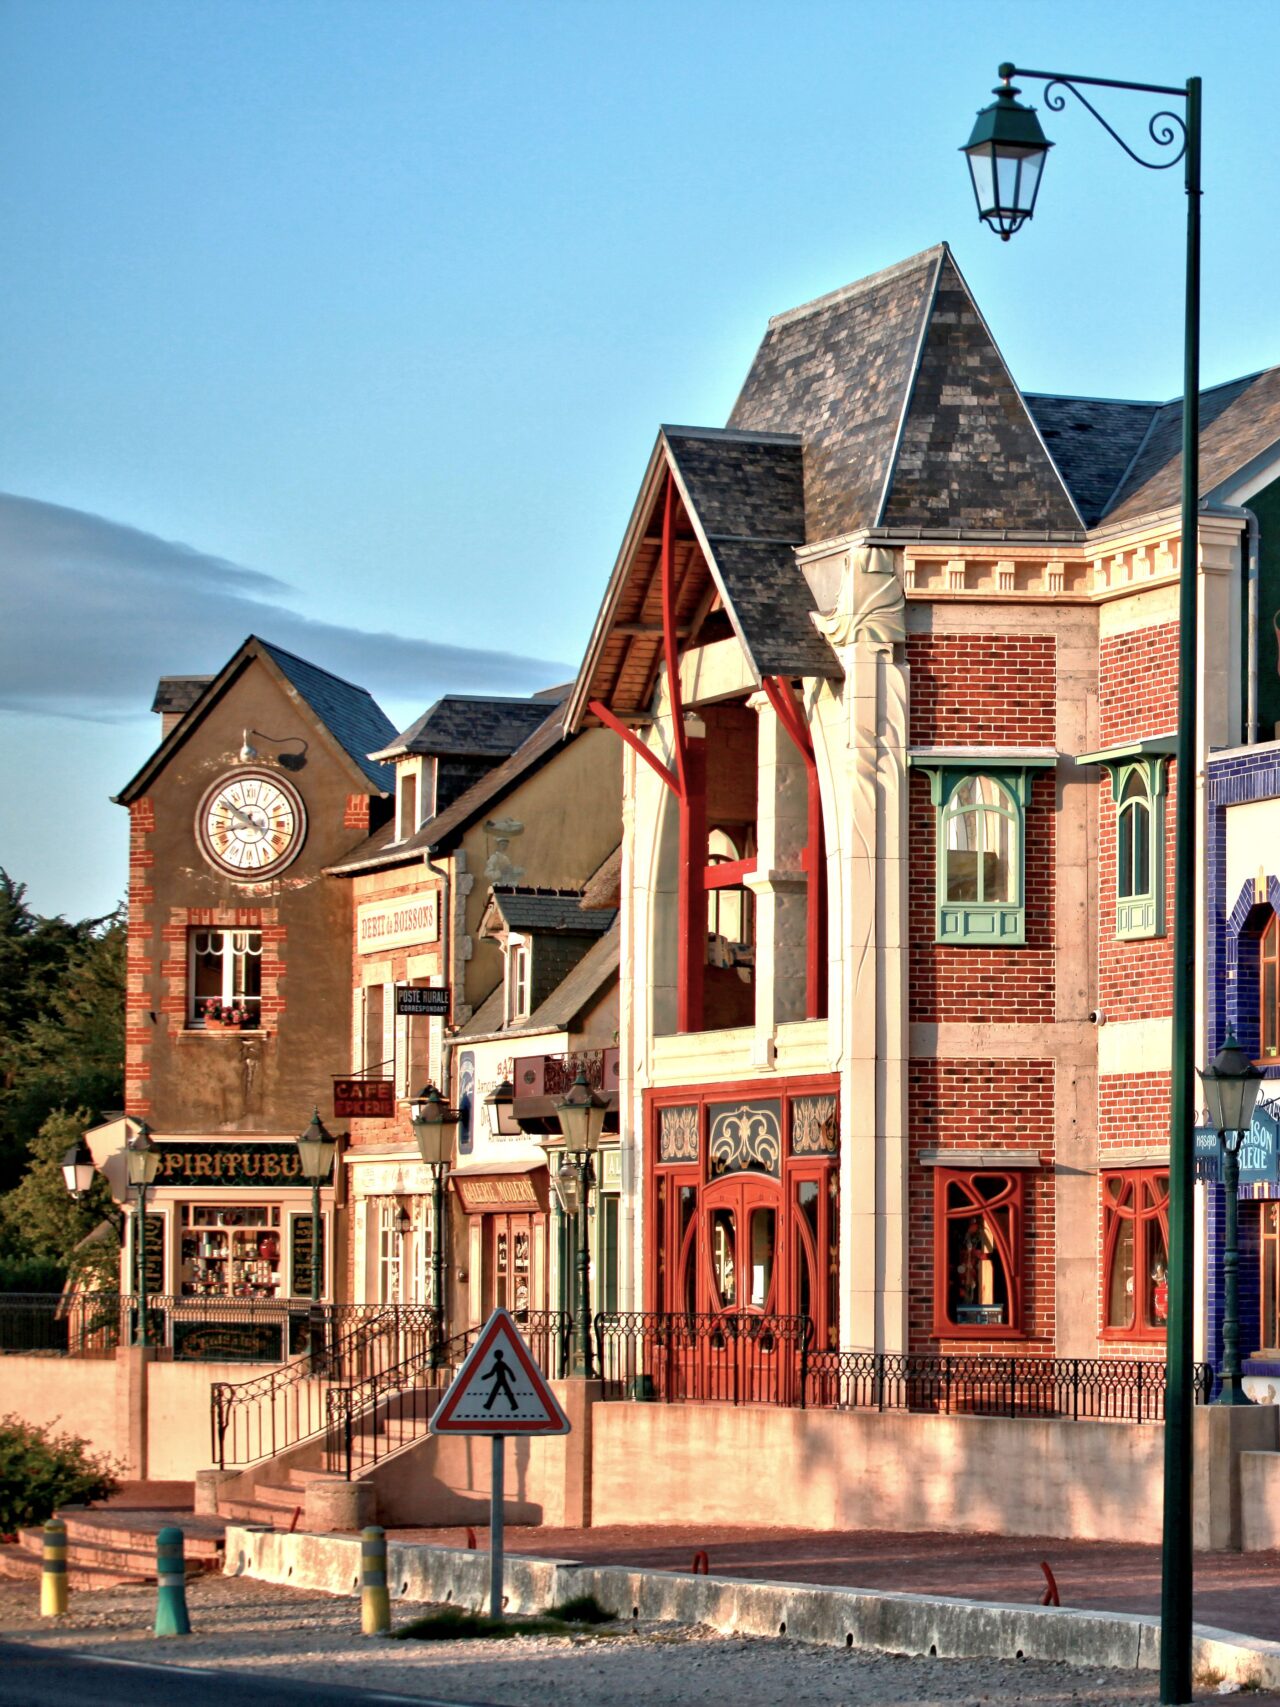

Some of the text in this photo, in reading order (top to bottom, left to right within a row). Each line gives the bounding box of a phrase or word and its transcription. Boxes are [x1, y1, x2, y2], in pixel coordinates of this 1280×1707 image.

[361, 914, 386, 939] DEBIT
[393, 904, 434, 933] BOISSONS
[398, 989, 449, 1004] POSTE RURALE
[400, 1004, 447, 1013] CORRESPONDANT
[496, 1056, 513, 1076] BAZ
[336, 1083, 390, 1098] CAFE
[154, 1153, 304, 1177] SPIRITUEU
[463, 1180, 537, 1202] GALERIE MODERNE
